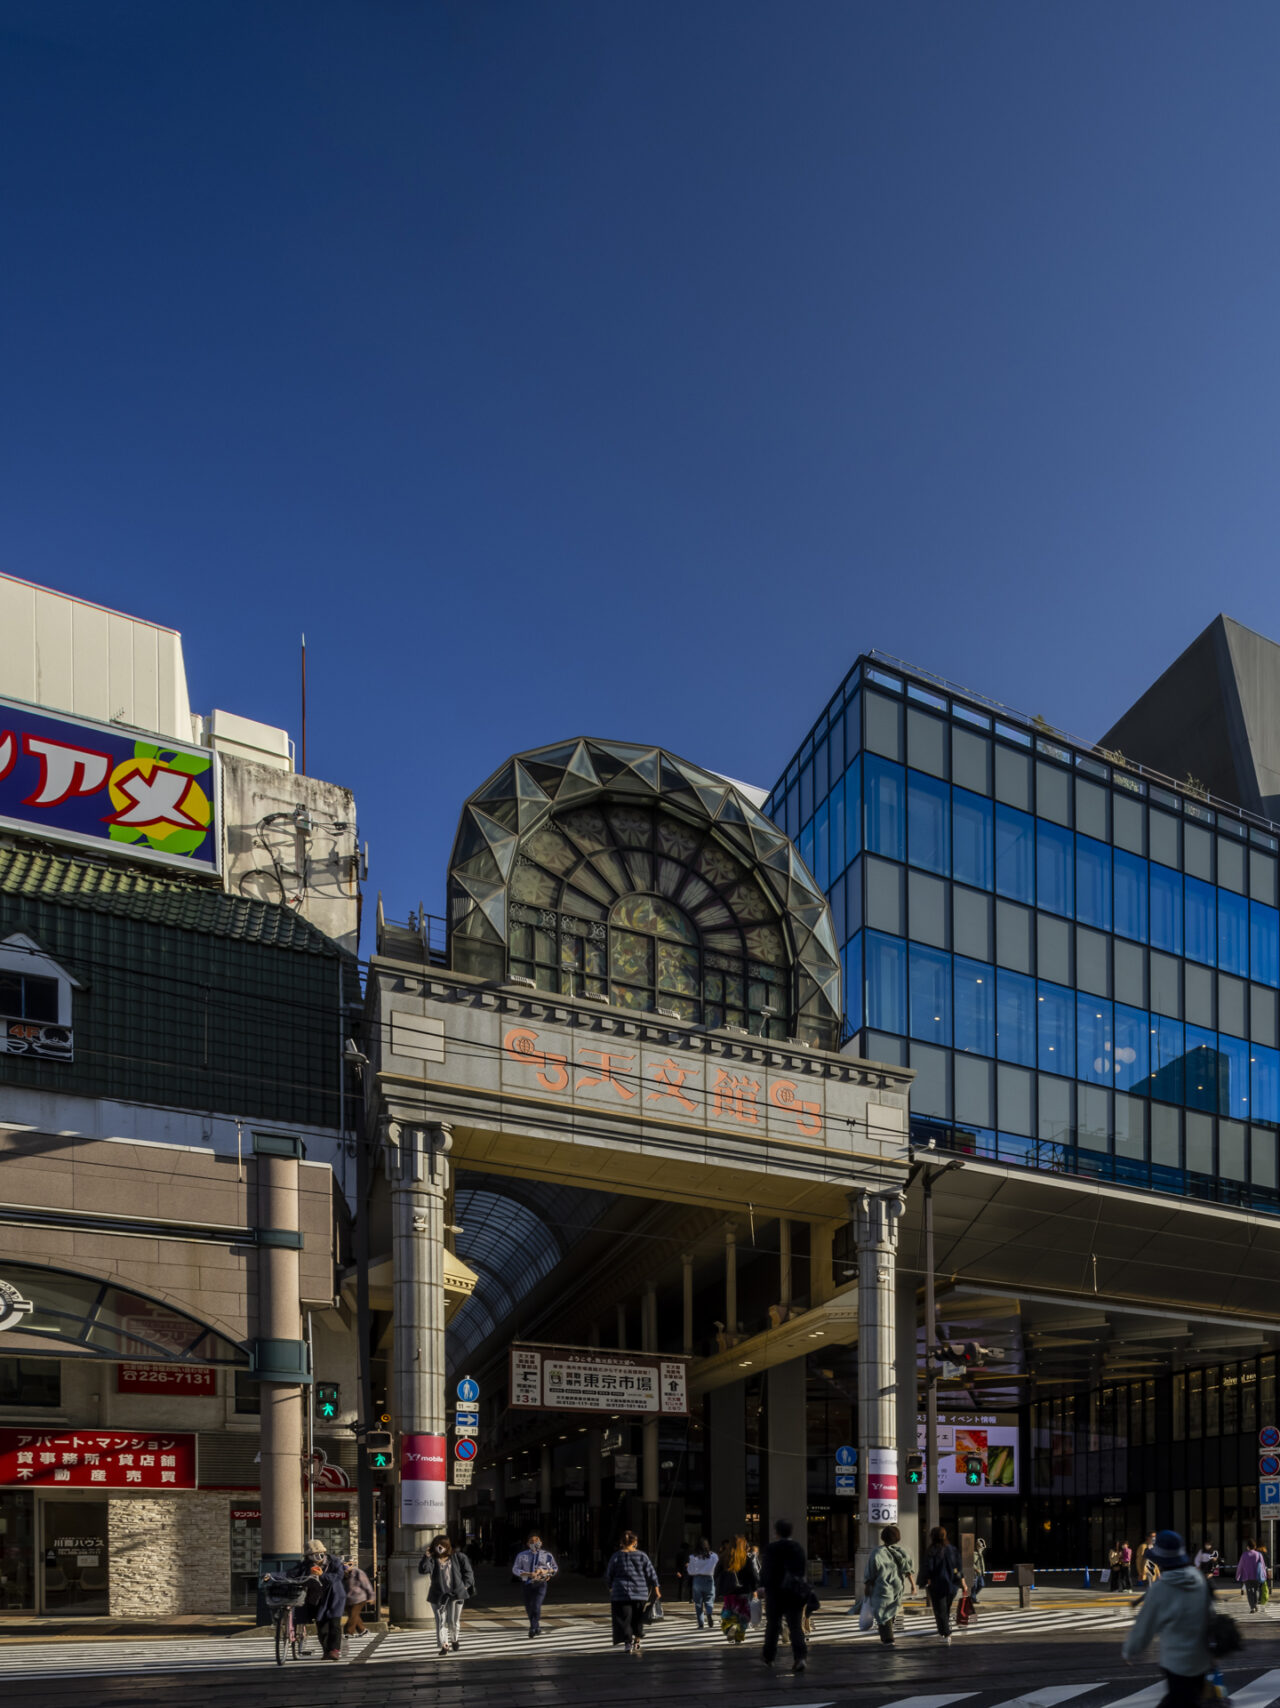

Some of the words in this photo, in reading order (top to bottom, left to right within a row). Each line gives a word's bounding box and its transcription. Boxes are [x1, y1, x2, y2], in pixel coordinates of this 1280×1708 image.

[9, 1024, 40, 1040] 4F
[576, 1047, 761, 1125] 天文館
[139, 1371, 211, 1385] 226-7131
[584, 1372, 653, 1392] 東京市場
[950, 1415, 997, 1424] イベント情報
[17, 1435, 176, 1450] アパート・マンション
[17, 1451, 176, 1467] 貸事務所・貸店舗
[17, 1468, 176, 1483] 不動産売買
[1265, 1485, 1276, 1502] P
